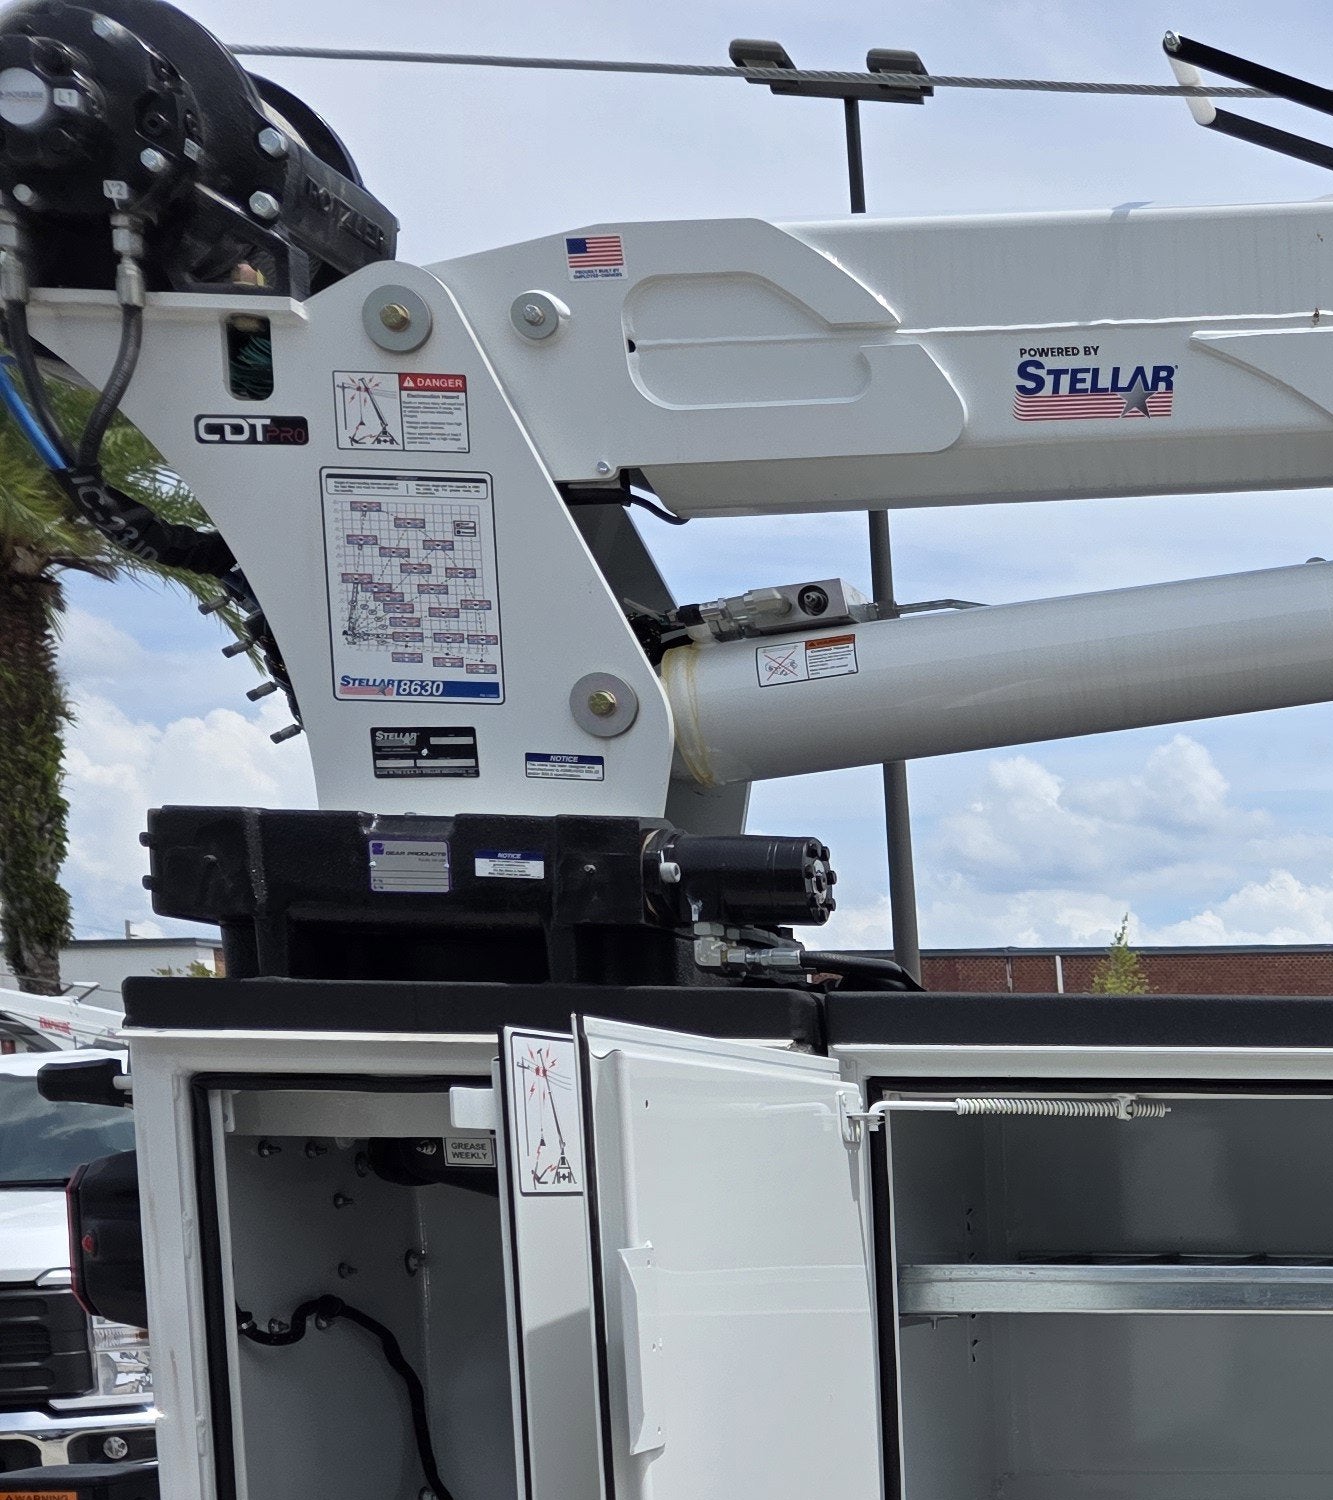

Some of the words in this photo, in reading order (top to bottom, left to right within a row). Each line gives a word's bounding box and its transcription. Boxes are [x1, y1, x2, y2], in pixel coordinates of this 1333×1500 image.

[1019, 346, 1080, 359] POWERED
[1083, 345, 1100, 356] BY
[416, 377, 464, 388] DANGER
[1015, 359, 1176, 396] STELLAR
[340, 675, 395, 688] STELLAR
[399, 680, 444, 696] 8630
[375, 731, 418, 741] STELLAR
[549, 755, 579, 763] NOTICE
[450, 1142, 487, 1151] GREASE
[451, 1151, 488, 1160] WEEKLY
